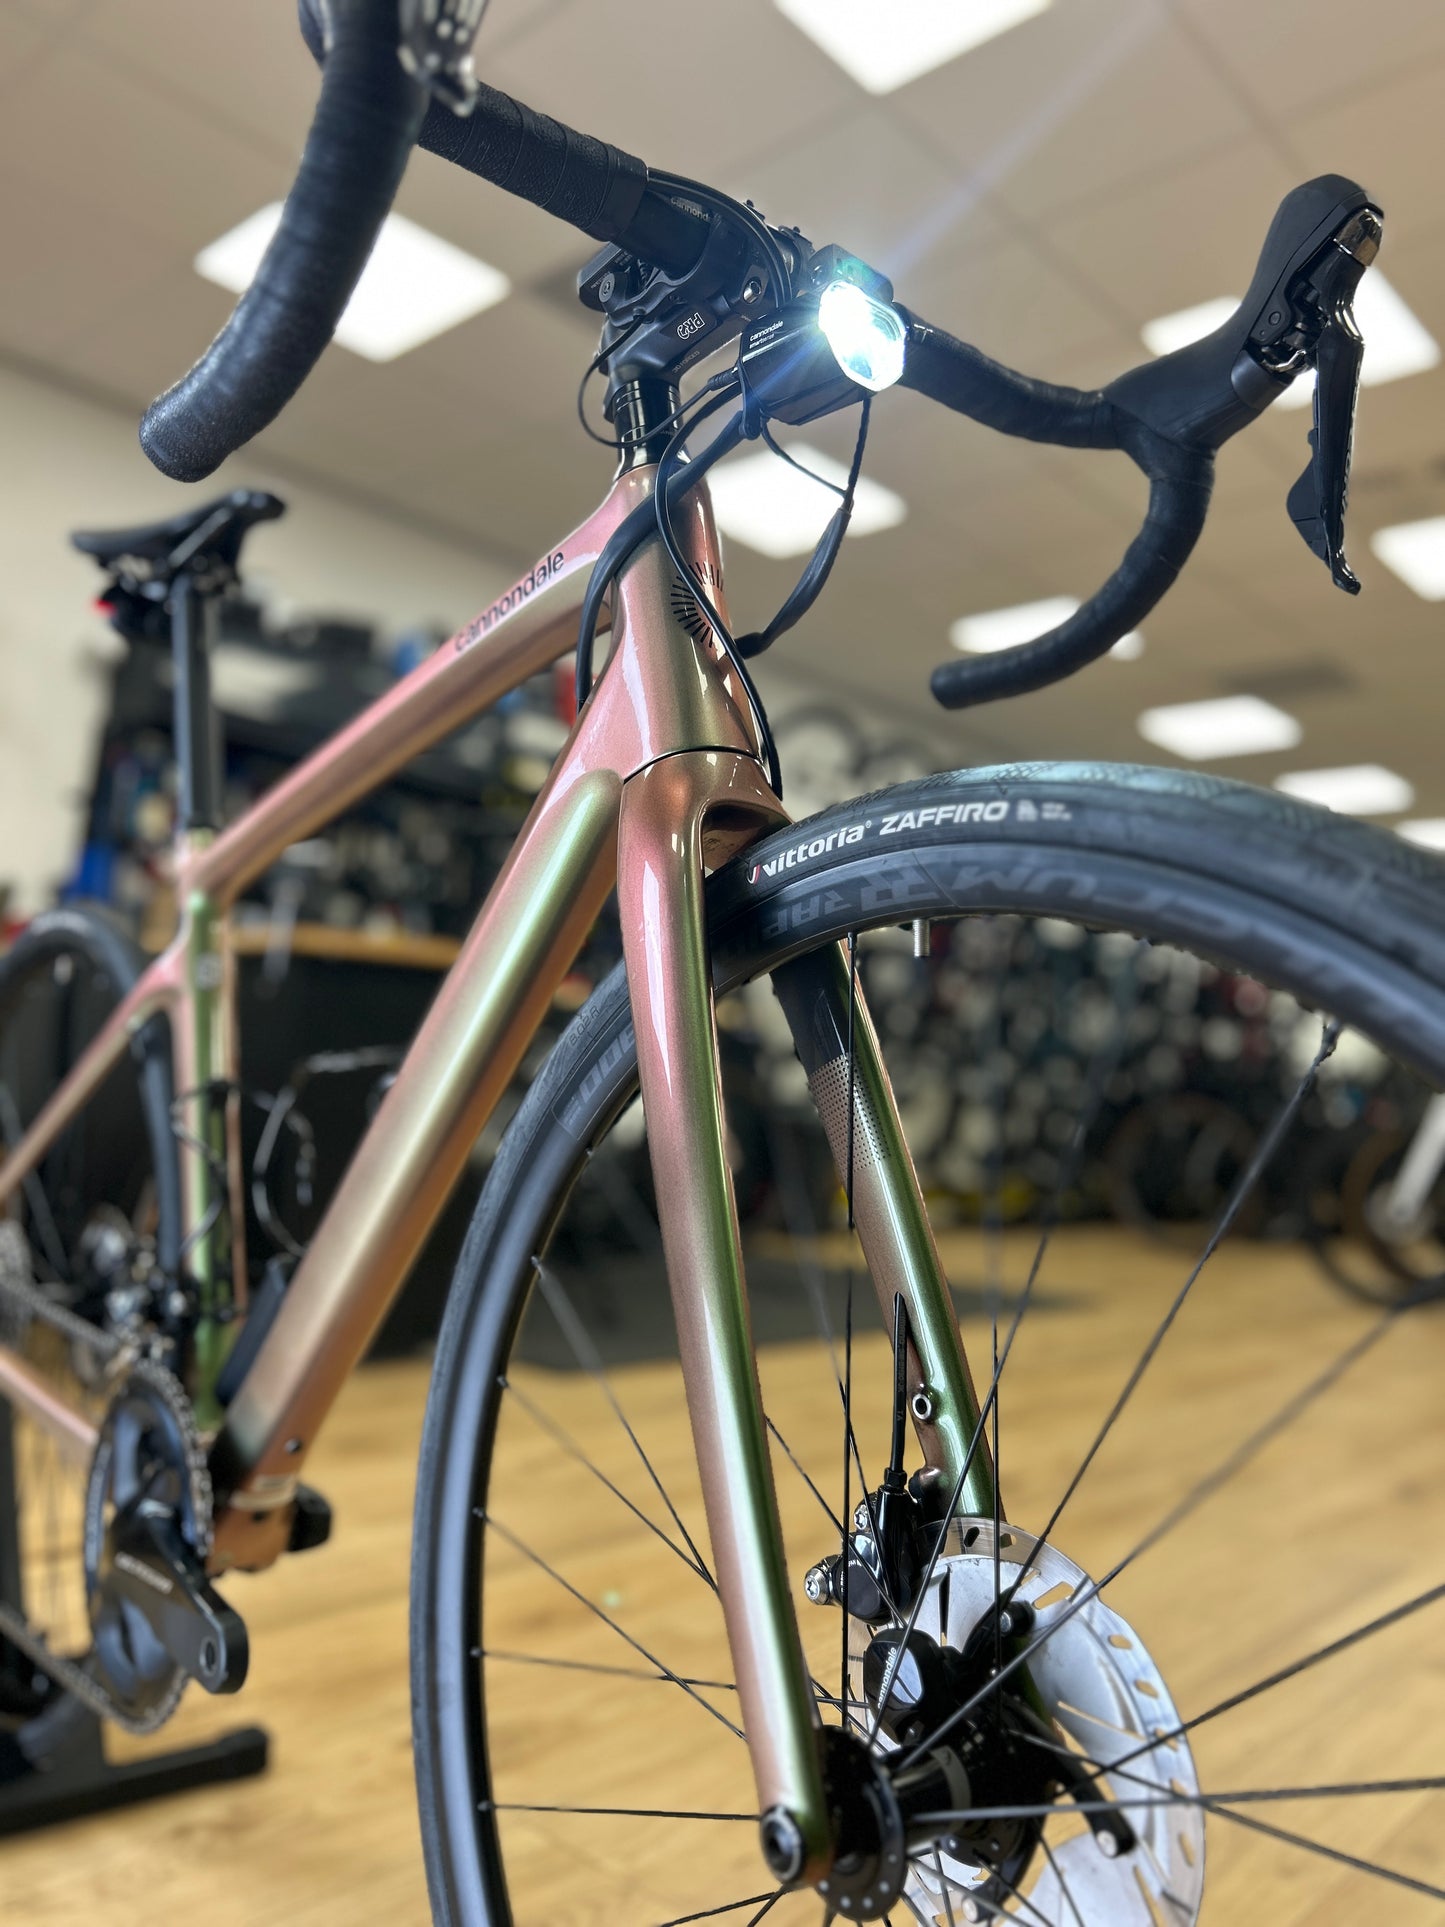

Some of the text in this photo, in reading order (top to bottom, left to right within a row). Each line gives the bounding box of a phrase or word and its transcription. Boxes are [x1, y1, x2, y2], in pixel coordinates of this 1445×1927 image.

[749, 320, 784, 342] cannondale
[455, 551, 564, 652] cannondale
[879, 801, 1010, 836] ZAFFIRO
